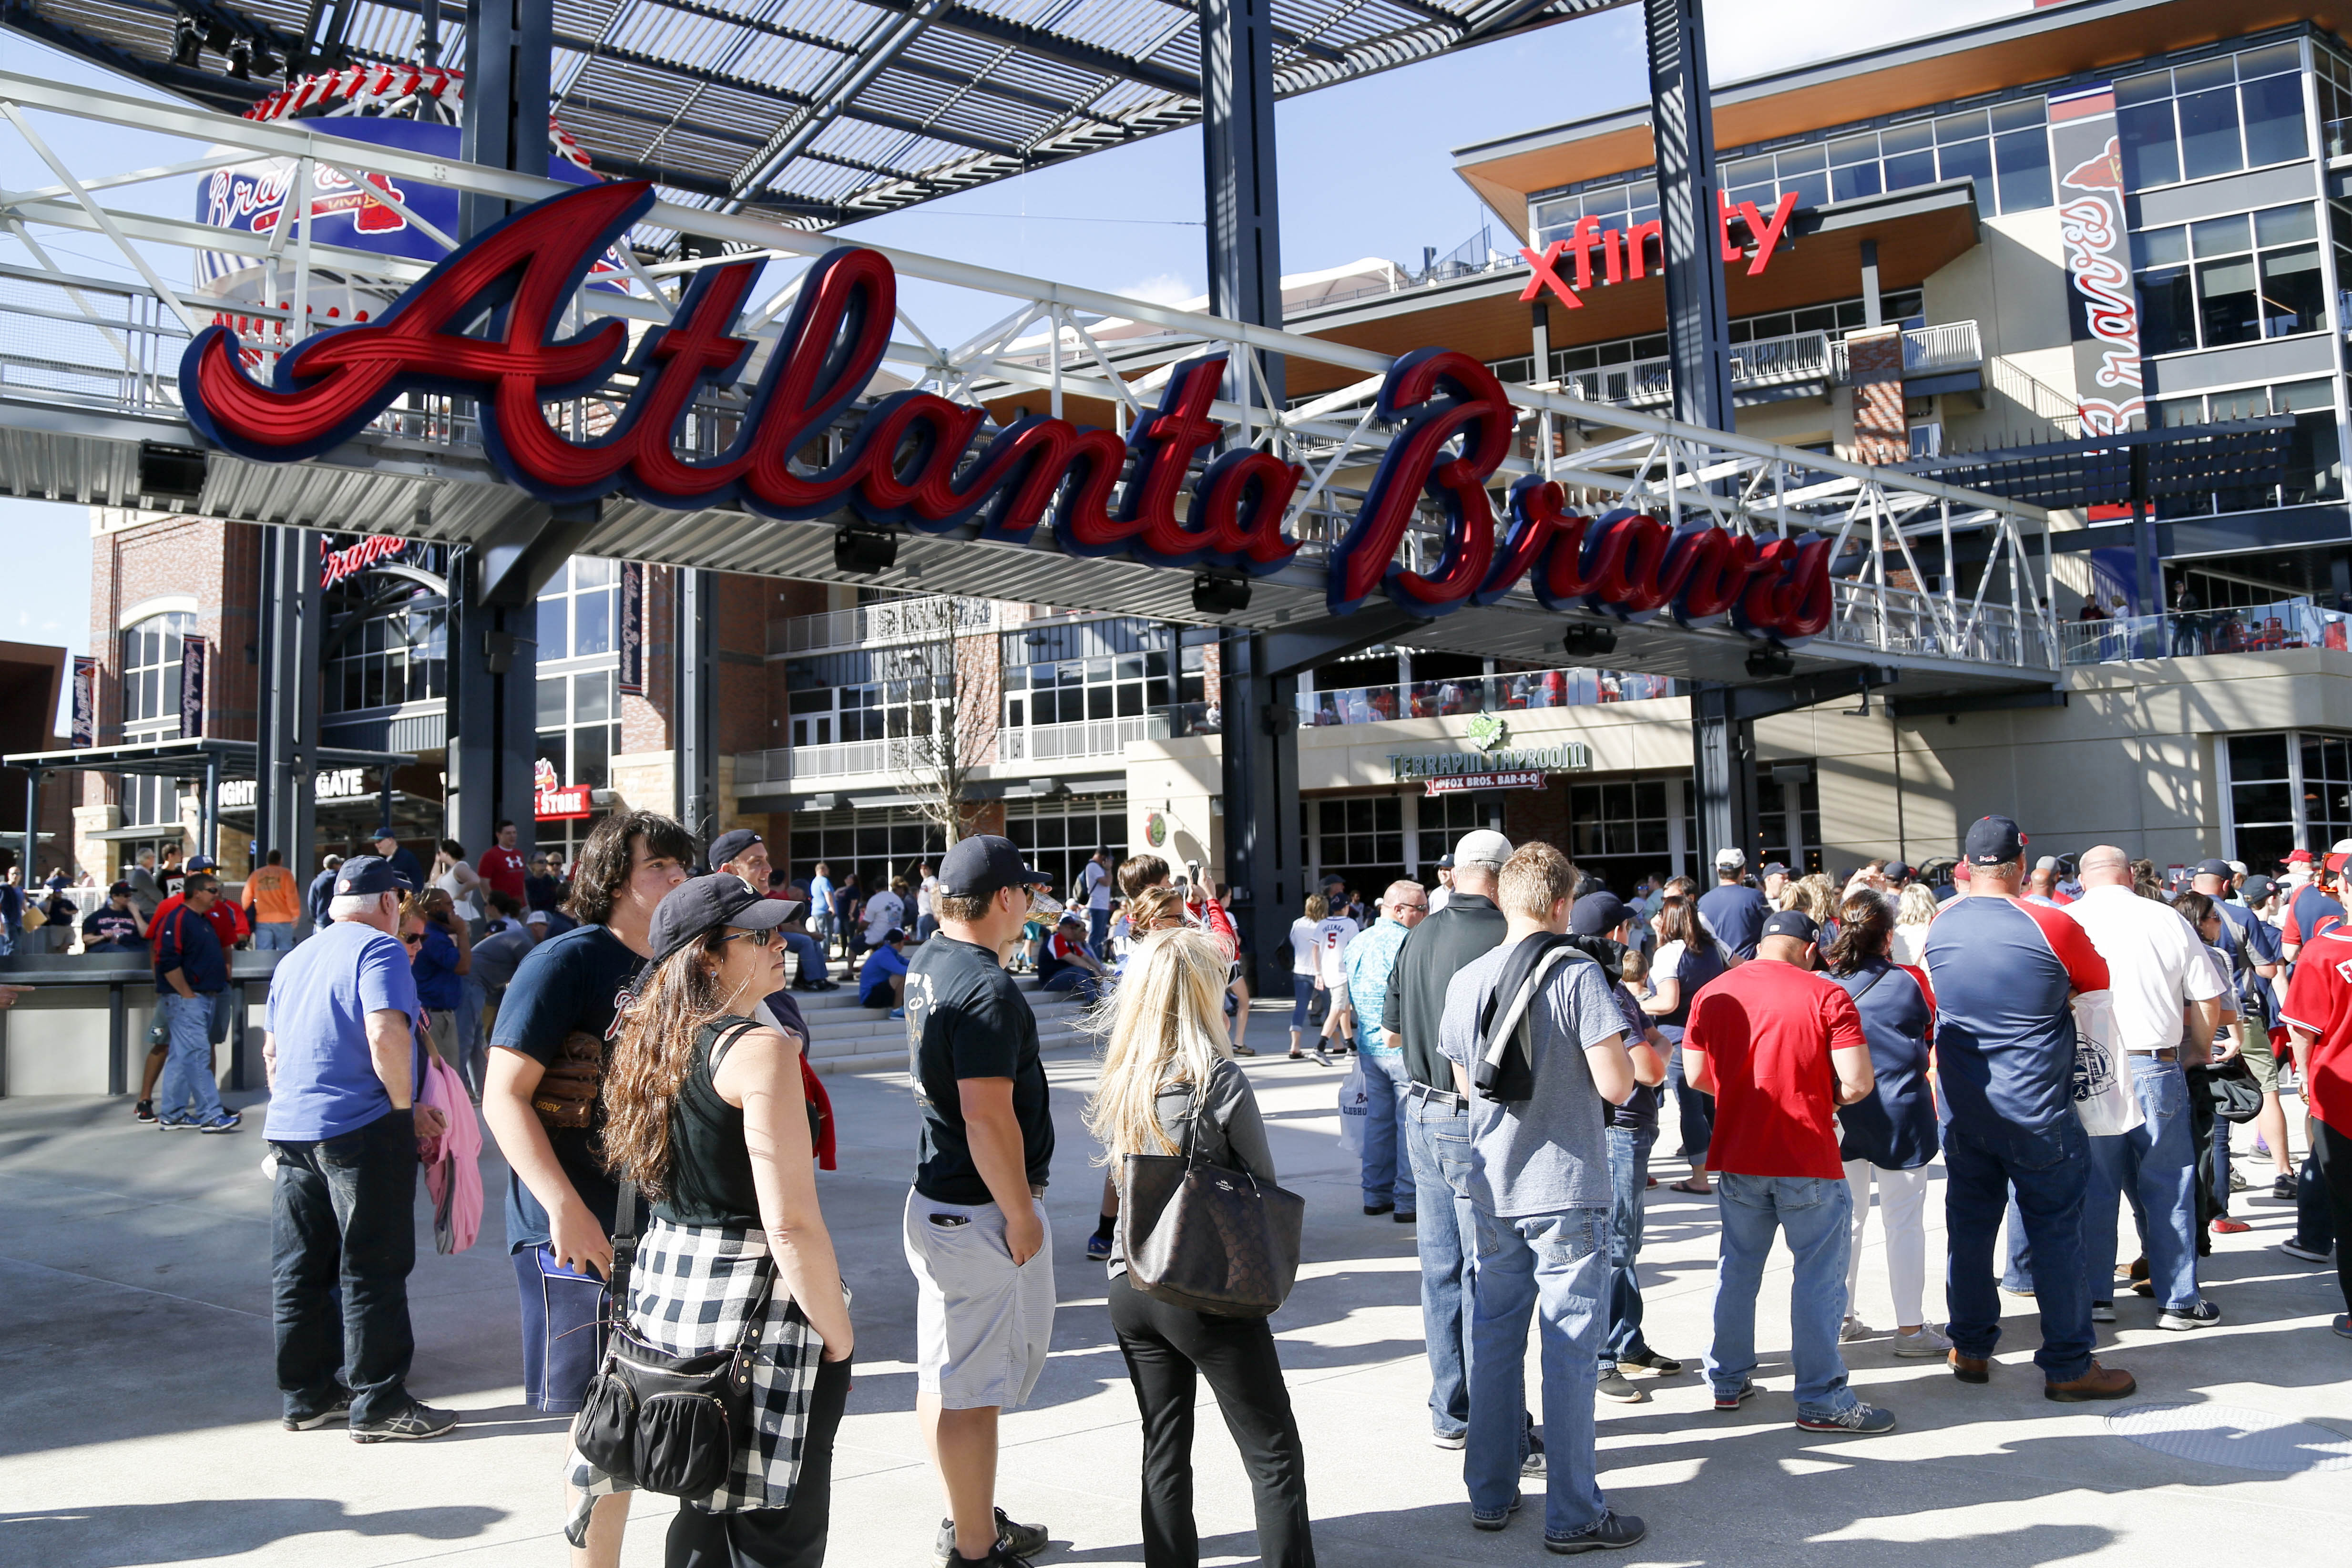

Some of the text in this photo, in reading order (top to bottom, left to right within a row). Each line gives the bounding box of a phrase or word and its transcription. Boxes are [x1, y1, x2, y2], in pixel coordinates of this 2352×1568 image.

[1518, 189, 1799, 309] xfinty
[179, 179, 1833, 642] Atlanta Braves
[72, 675, 92, 738] Braves
[1386, 741, 1586, 778] TERRAPIN TAPROOM
[205, 768, 363, 807] IGHT GATE
[1445, 778, 1465, 788] FOX
[1466, 776, 1494, 787] BROS.
[1497, 773, 1538, 785] BAR-B-Q
[541, 793, 581, 814] STORE
[1322, 924, 1345, 933] FREEMAN
[1328, 933, 1337, 949] 5
[536, 1100, 561, 1113] A800
